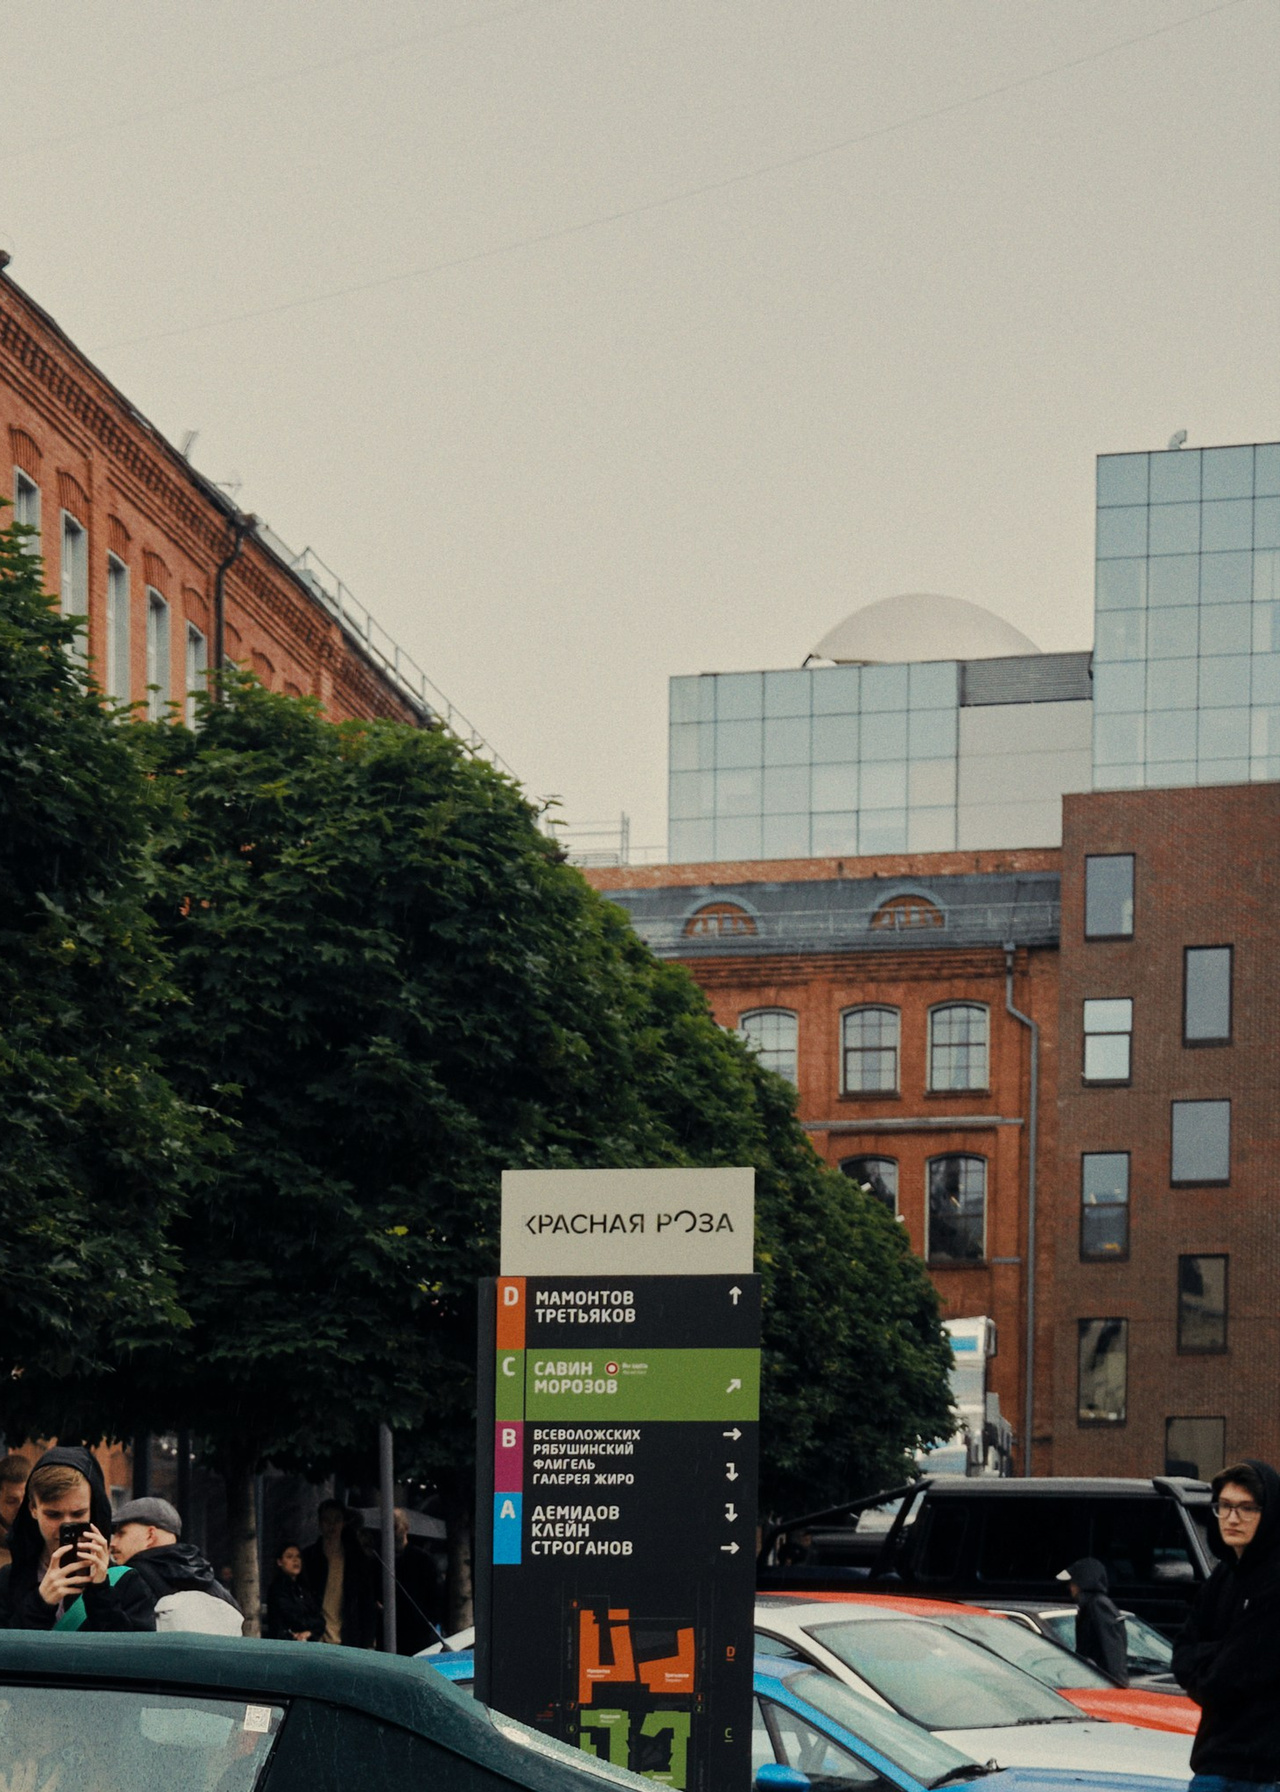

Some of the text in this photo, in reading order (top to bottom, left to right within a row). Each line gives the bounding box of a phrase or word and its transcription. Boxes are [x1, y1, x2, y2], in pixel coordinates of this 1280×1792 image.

[656, 1209, 734, 1233] РОЗА
[503, 1286, 519, 1307] D
[535, 1290, 635, 1306] МАМОНТОВ
[534, 1308, 637, 1324] ТРЕТЬЯКОВ
[502, 1356, 516, 1377] C
[533, 1361, 593, 1376] САВИН
[533, 1379, 618, 1394] МОРОЗОВ
[502, 1428, 517, 1448] B
[533, 1428, 641, 1441] ВСЕВОЛОЖСКИХ
[532, 1441, 635, 1455] РЯБУШИНСКИЙ
[532, 1458, 596, 1470] ФЛИГЕЛЬ
[532, 1473, 635, 1485] ГАЛЕРЕЯ ЖИРО
[500, 1499, 516, 1519] A
[531, 1505, 620, 1522] ДЕМИДОВ
[531, 1520, 590, 1538] КЛЕЙН
[531, 1540, 634, 1556] СТРОГАНОВ
[726, 1646, 736, 1657] D
